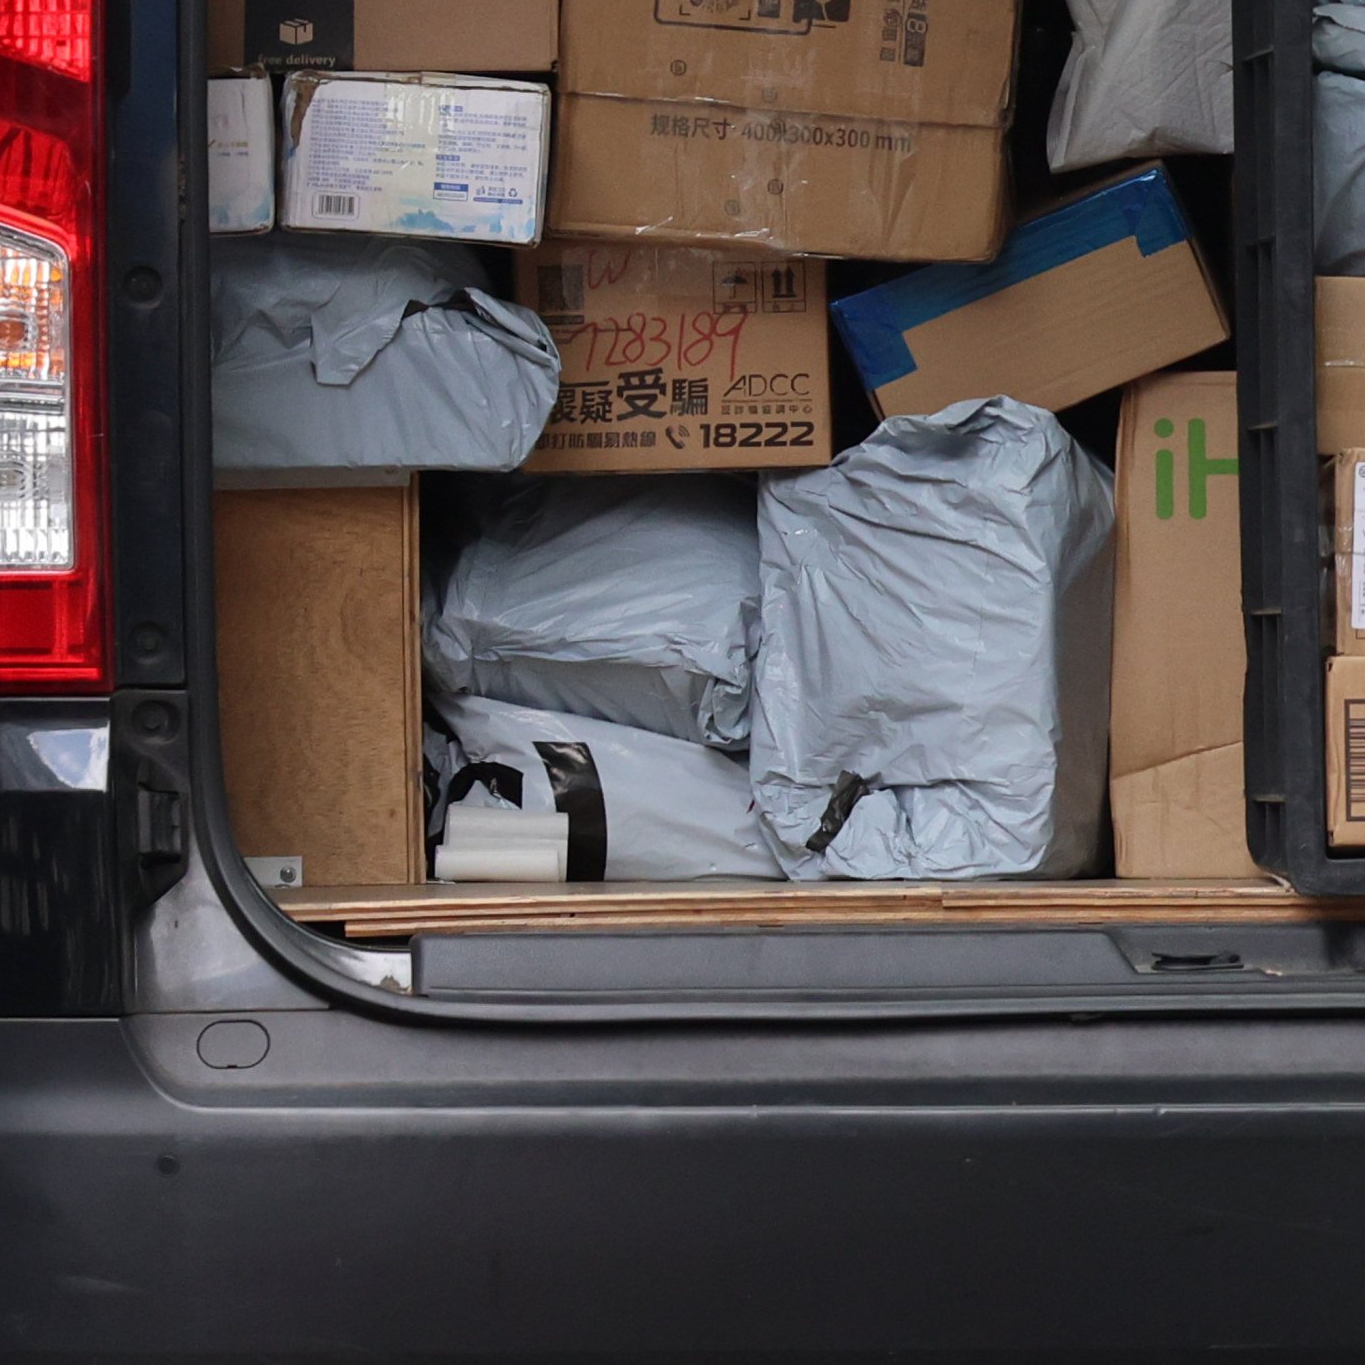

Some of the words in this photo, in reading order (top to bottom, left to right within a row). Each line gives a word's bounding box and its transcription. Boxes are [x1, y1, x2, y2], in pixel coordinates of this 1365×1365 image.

[256, 53, 280, 66] free
[284, 53, 336, 68] delivery
[723, 373, 811, 397] ADCC
[699, 420, 816, 449] 18222
